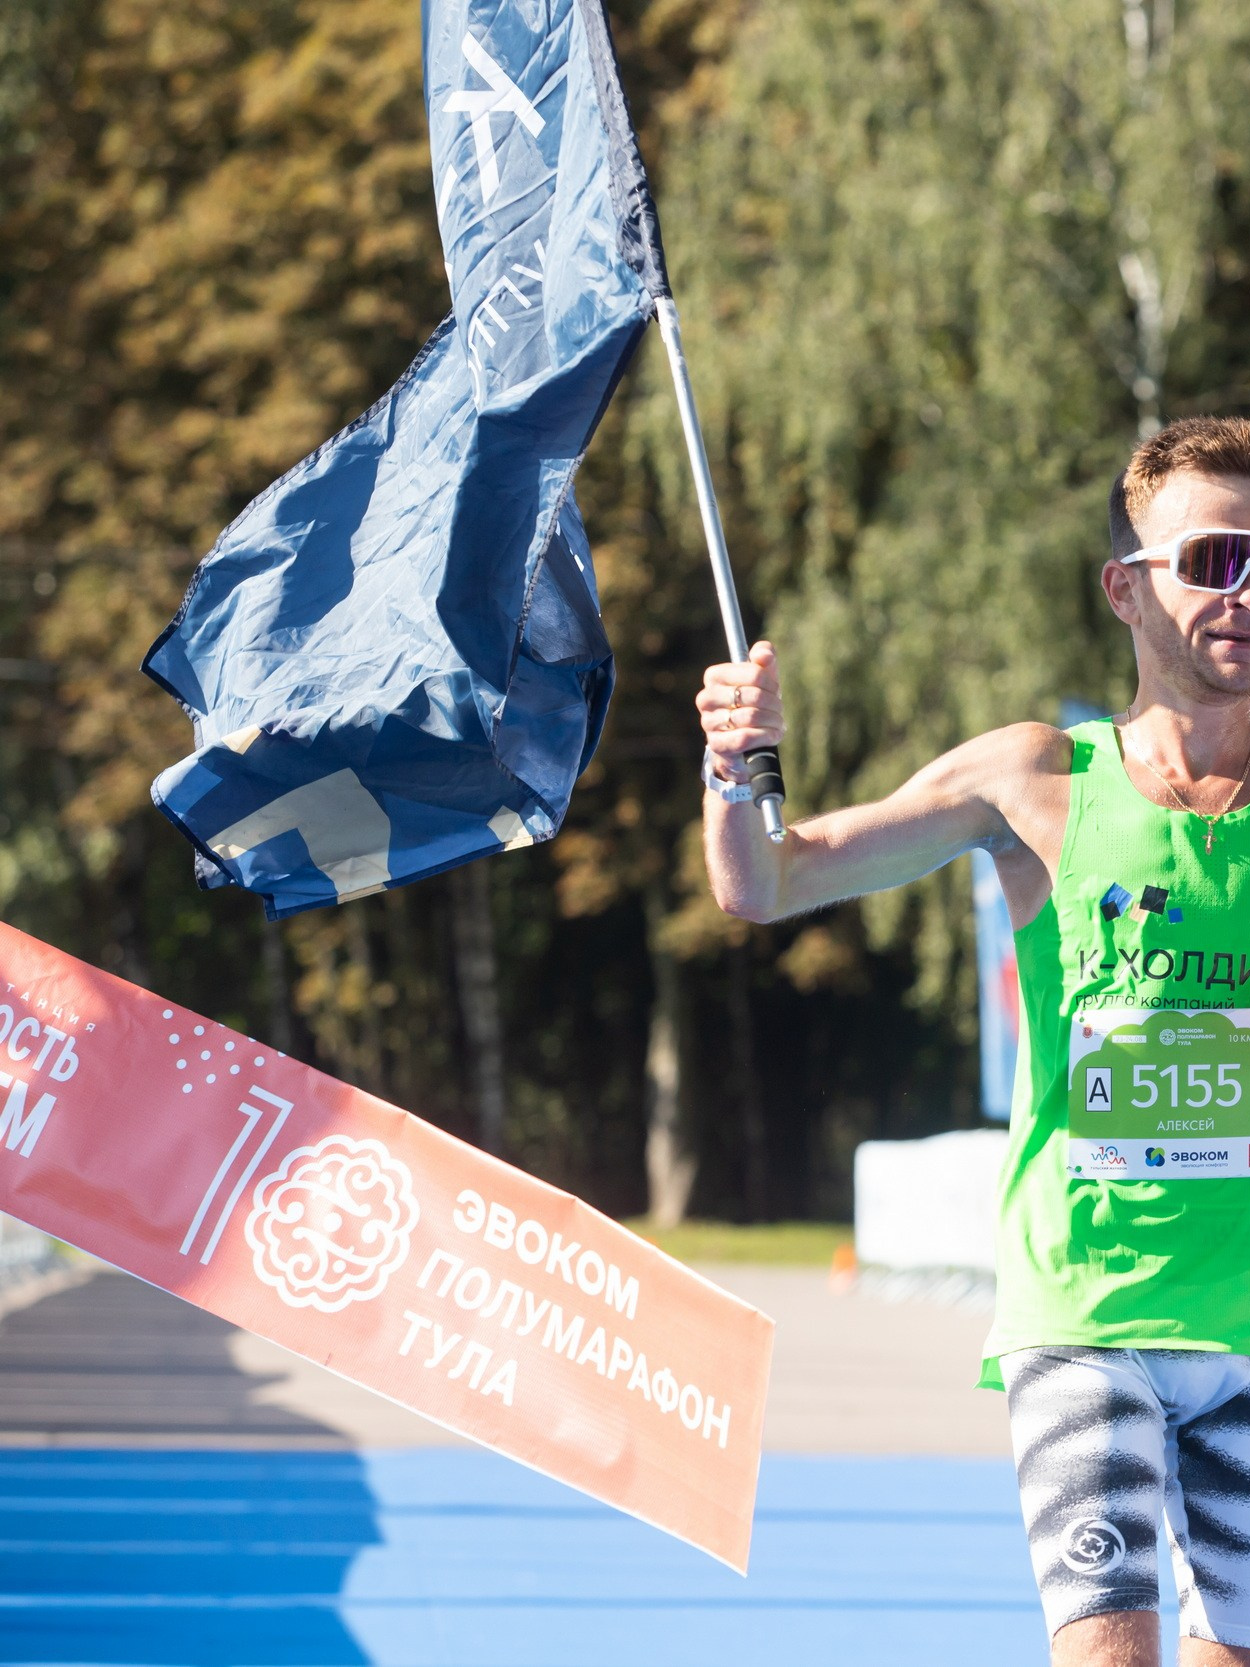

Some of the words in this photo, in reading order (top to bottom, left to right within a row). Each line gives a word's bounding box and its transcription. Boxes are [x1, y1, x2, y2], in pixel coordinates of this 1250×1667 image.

[1141, 996, 1235, 1010] компаний
[1228, 1034, 1238, 1042] 10
[1130, 1063, 1243, 1108] 5155
[1156, 1118, 1215, 1131] АЛЕКСЕЙ
[1171, 1150, 1228, 1162] ЭВОКОМ
[453, 1188, 640, 1321] ЭВОКОМ
[398, 1309, 519, 1407] ТУЛА
[416, 1247, 732, 1450] ПОЛУМАРАФОН
